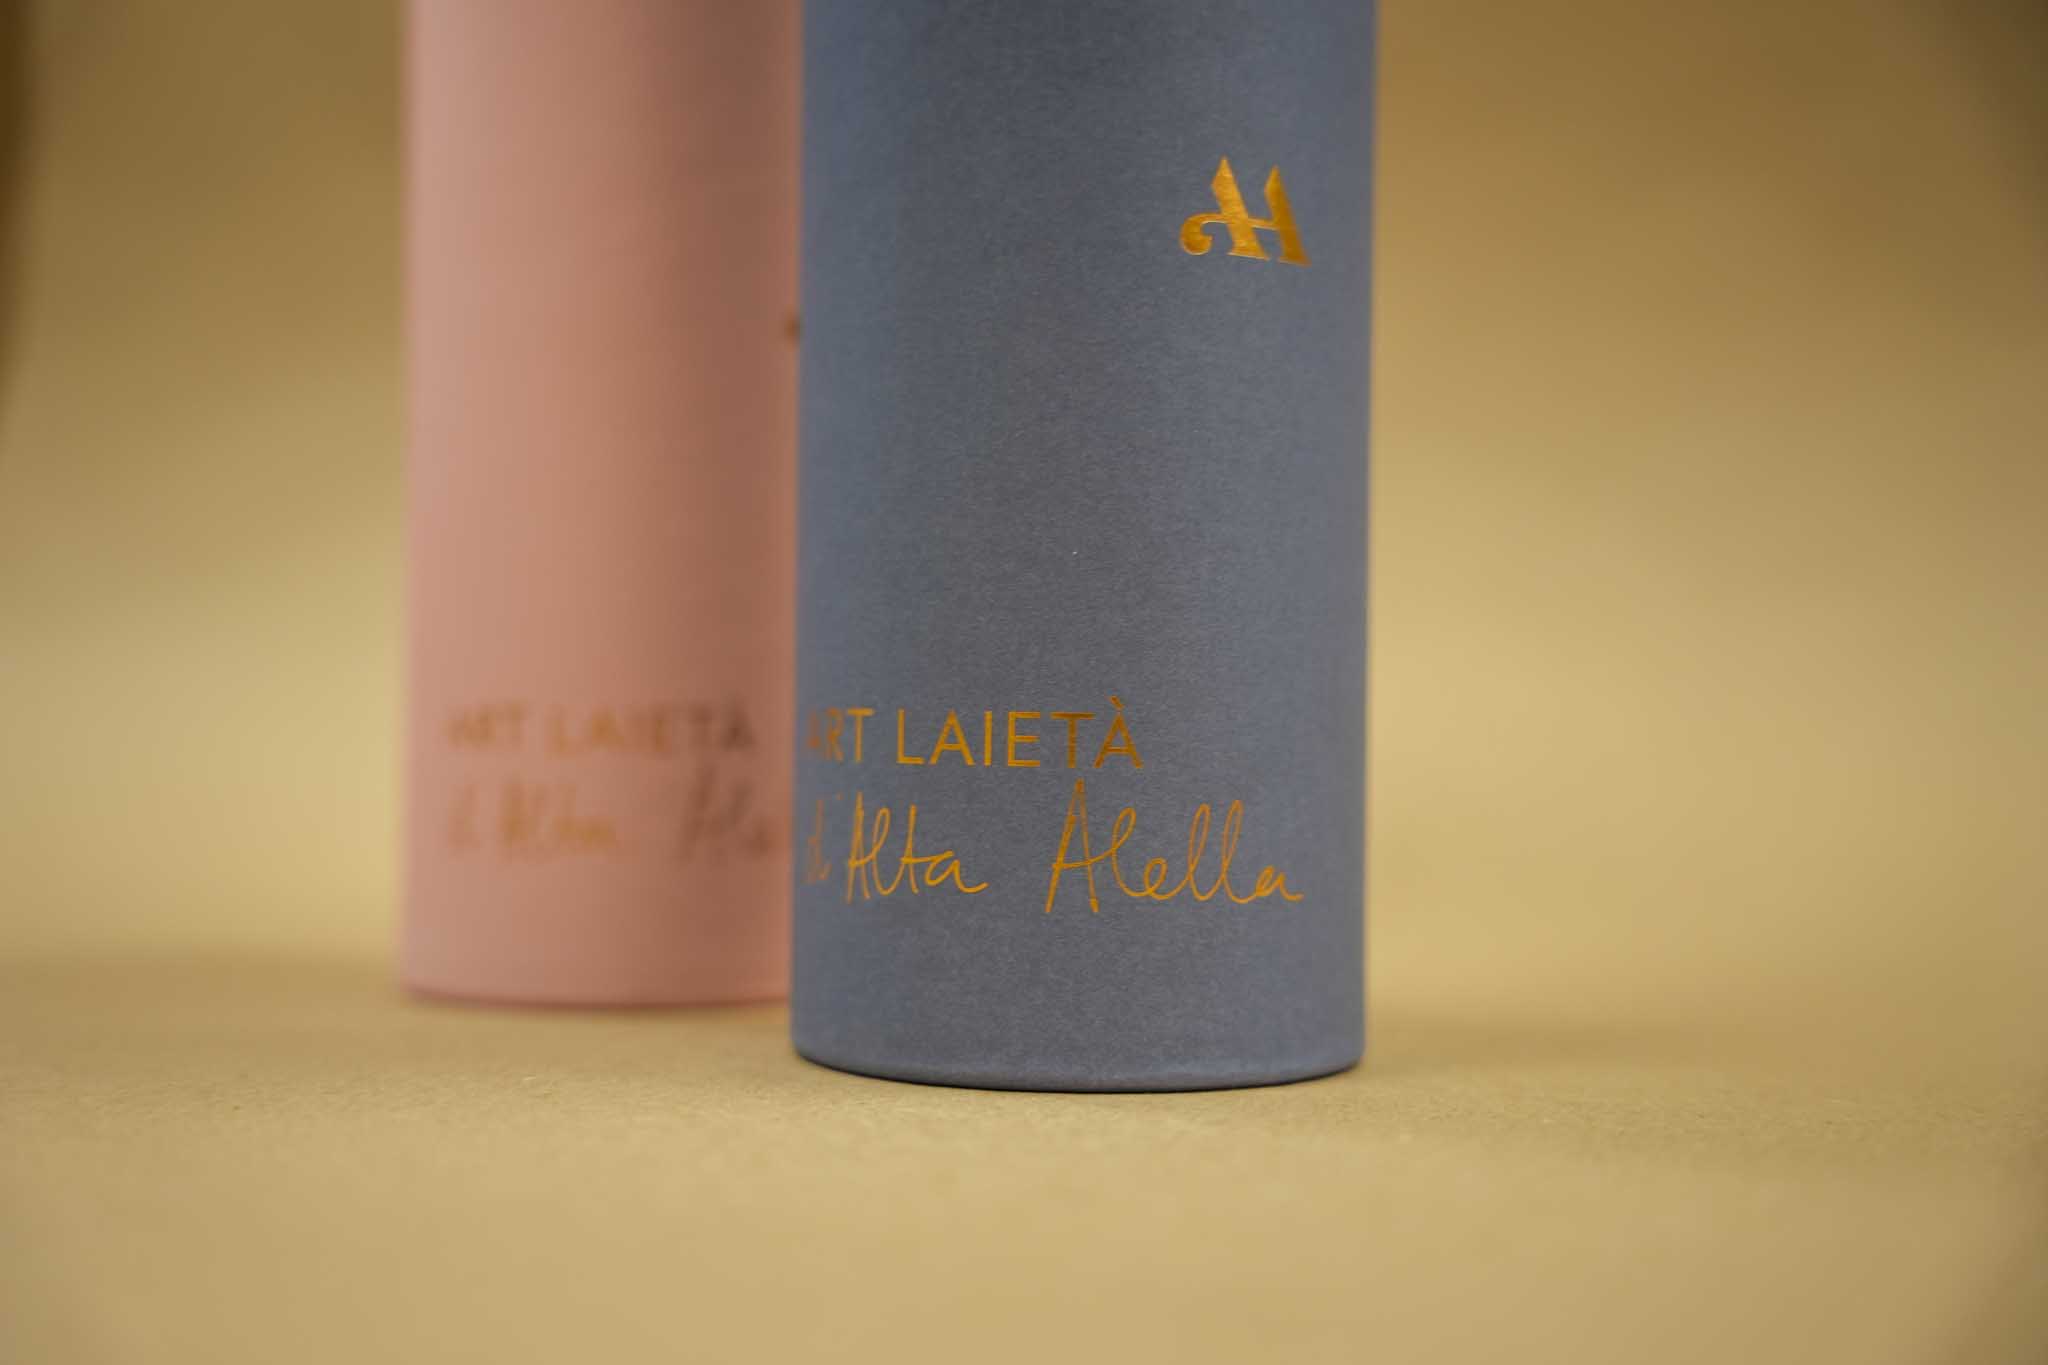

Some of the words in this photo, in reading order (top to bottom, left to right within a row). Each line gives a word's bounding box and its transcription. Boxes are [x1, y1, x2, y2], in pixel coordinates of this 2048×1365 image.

[806, 708, 875, 763] ART
[896, 695, 1143, 768] LAIETÀ
[1045, 778, 1304, 913] Alella
